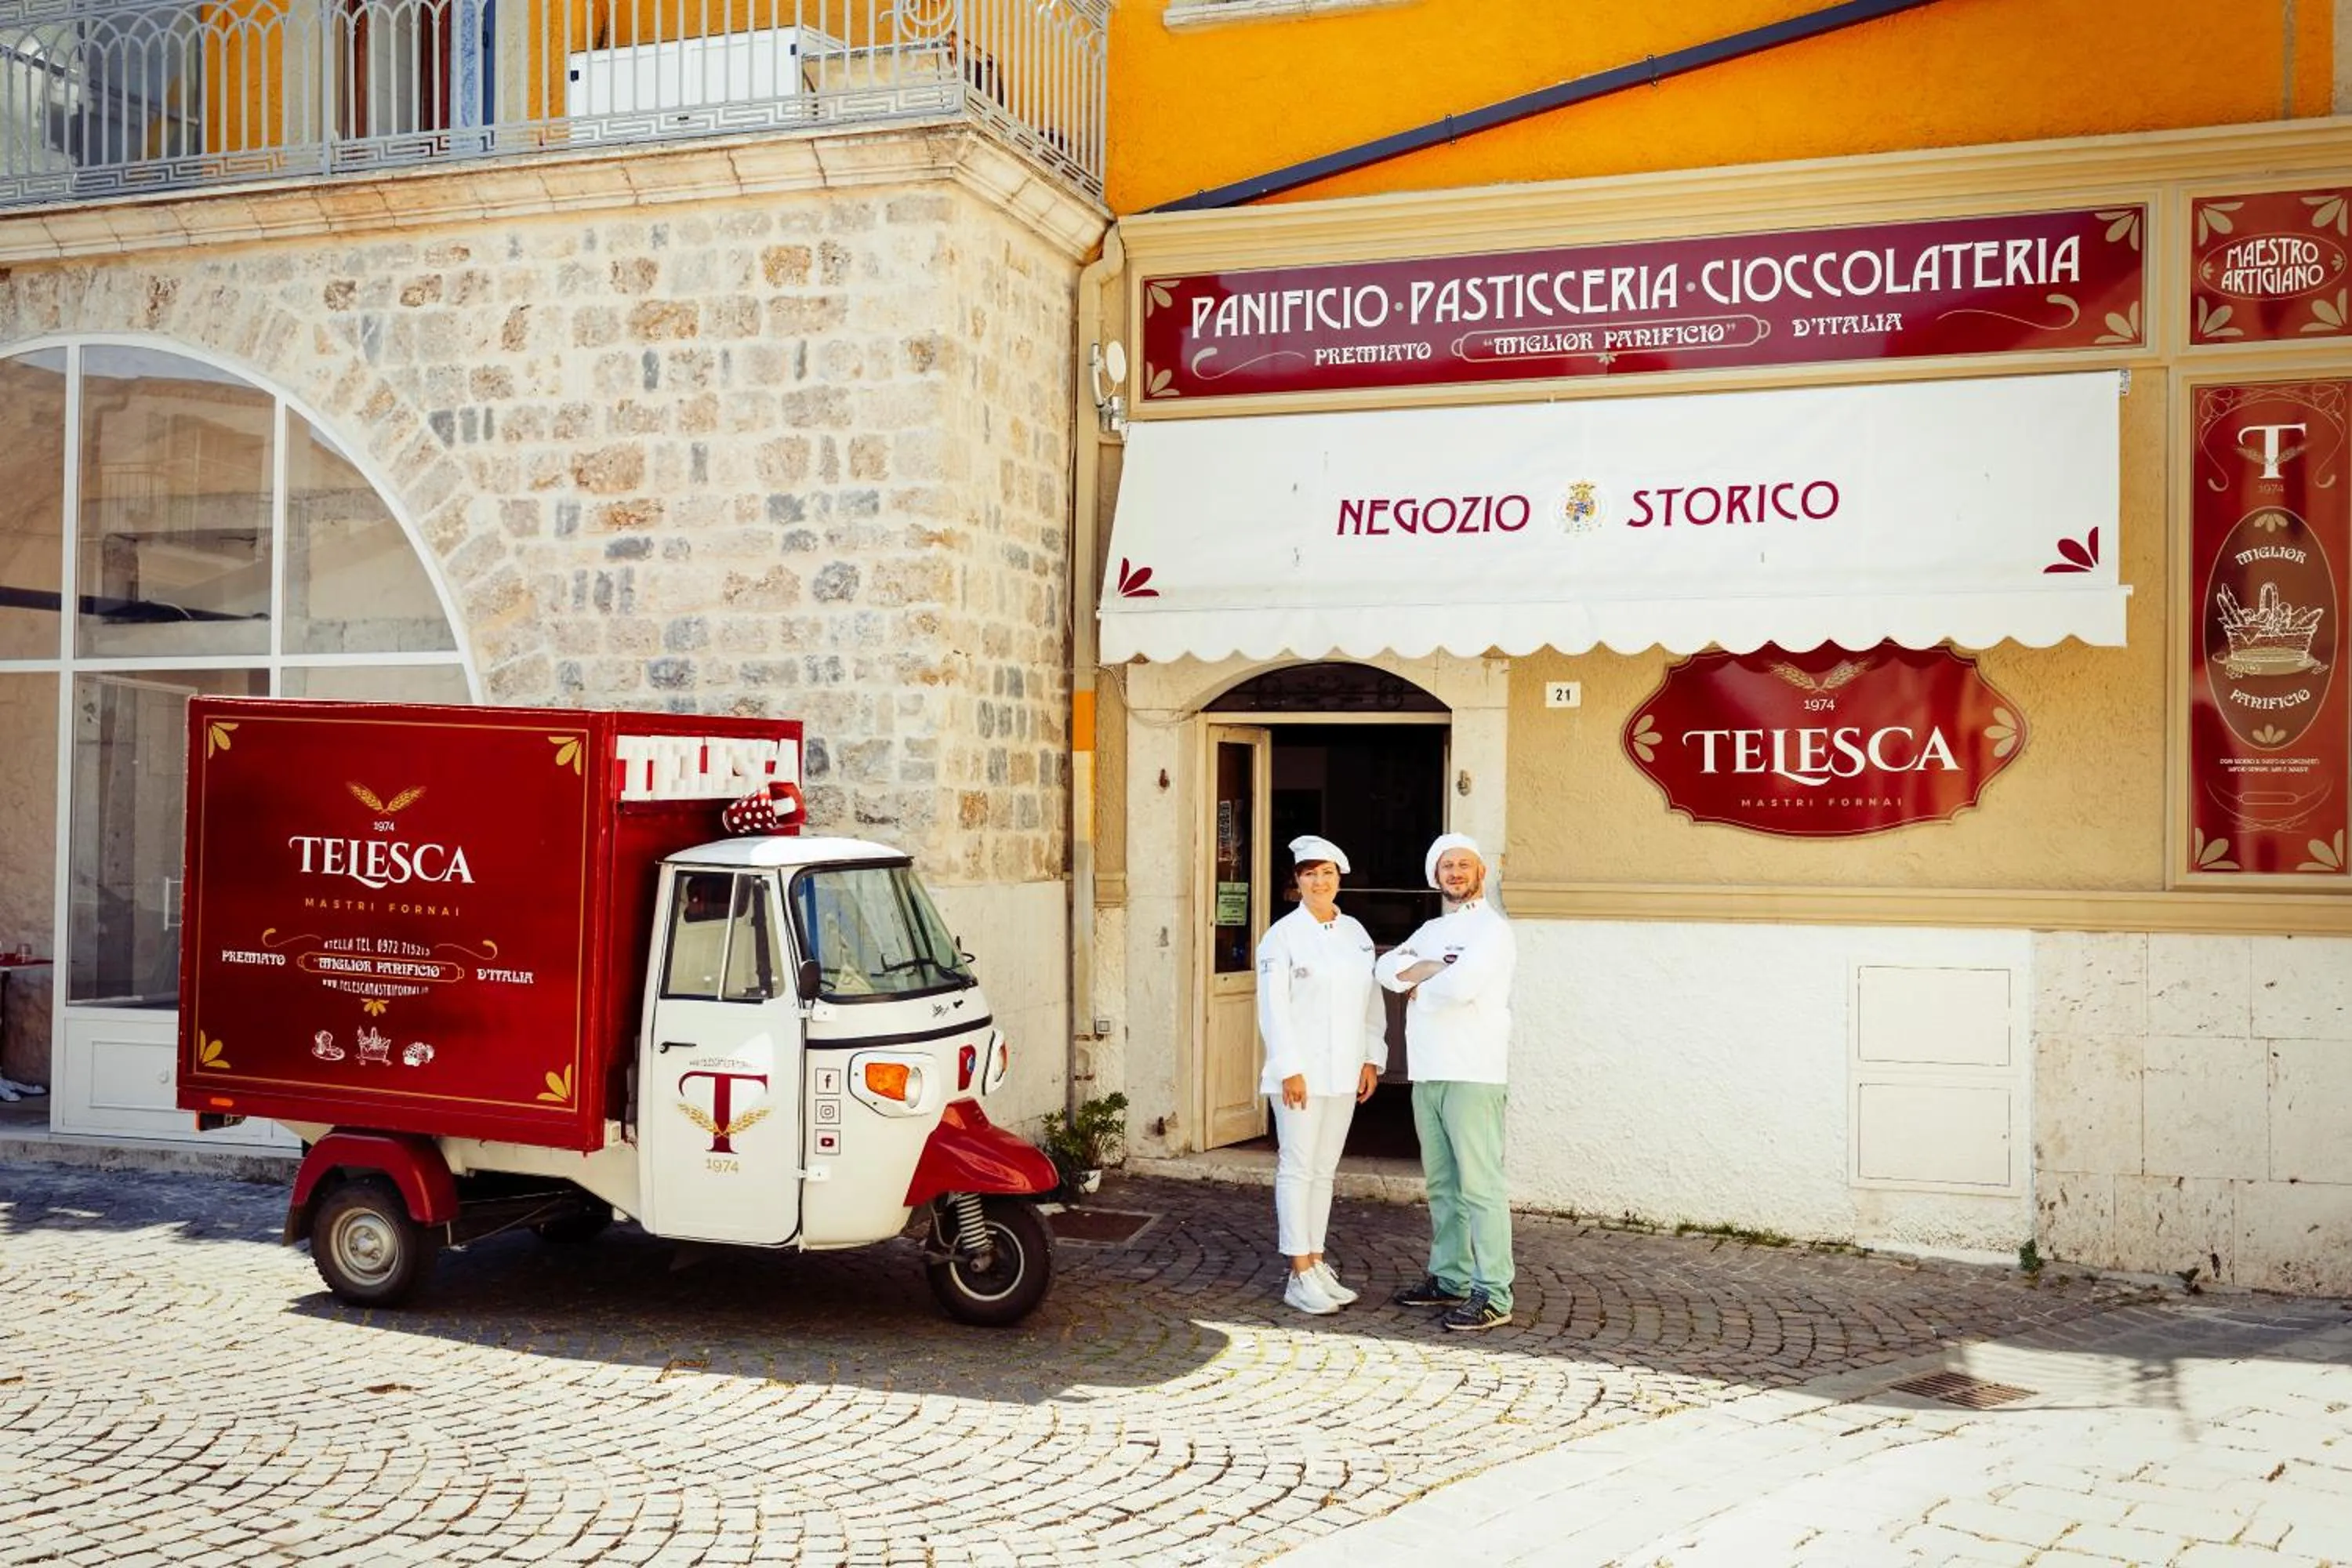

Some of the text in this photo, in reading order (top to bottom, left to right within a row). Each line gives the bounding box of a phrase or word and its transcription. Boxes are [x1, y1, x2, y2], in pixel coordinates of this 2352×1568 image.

[2226, 238, 2319, 269] MAESTRO
[1191, 235, 2080, 339] PANIFICIO PASTICCERIA CIOCCOLATERIA
[2221, 264, 2325, 294] ARTIGIANO
[1793, 312, 1904, 337] D'ITALIA
[1314, 341, 1432, 366] PREMIATO
[2238, 423, 2307, 480] T
[1337, 481, 1839, 535] NEGOZIO STORICO
[2234, 546, 2307, 565] MIGLIOR
[1555, 688, 1571, 702] 21
[1803, 698, 1835, 711] 1974
[2230, 688, 2311, 710] PANIFICIO
[1682, 726, 1962, 787] TELESCA
[1741, 797, 1903, 808] MASTRI FORNAI
[373, 821, 395, 832] 1974
[289, 836, 475, 888] TELESCA
[305, 898, 459, 916] MASTRI FORNAI
[222, 949, 285, 966] PREMIATO
[477, 968, 534, 984] D'ITALIA
[678, 1070, 768, 1155] T
[706, 1157, 739, 1174] 1974
